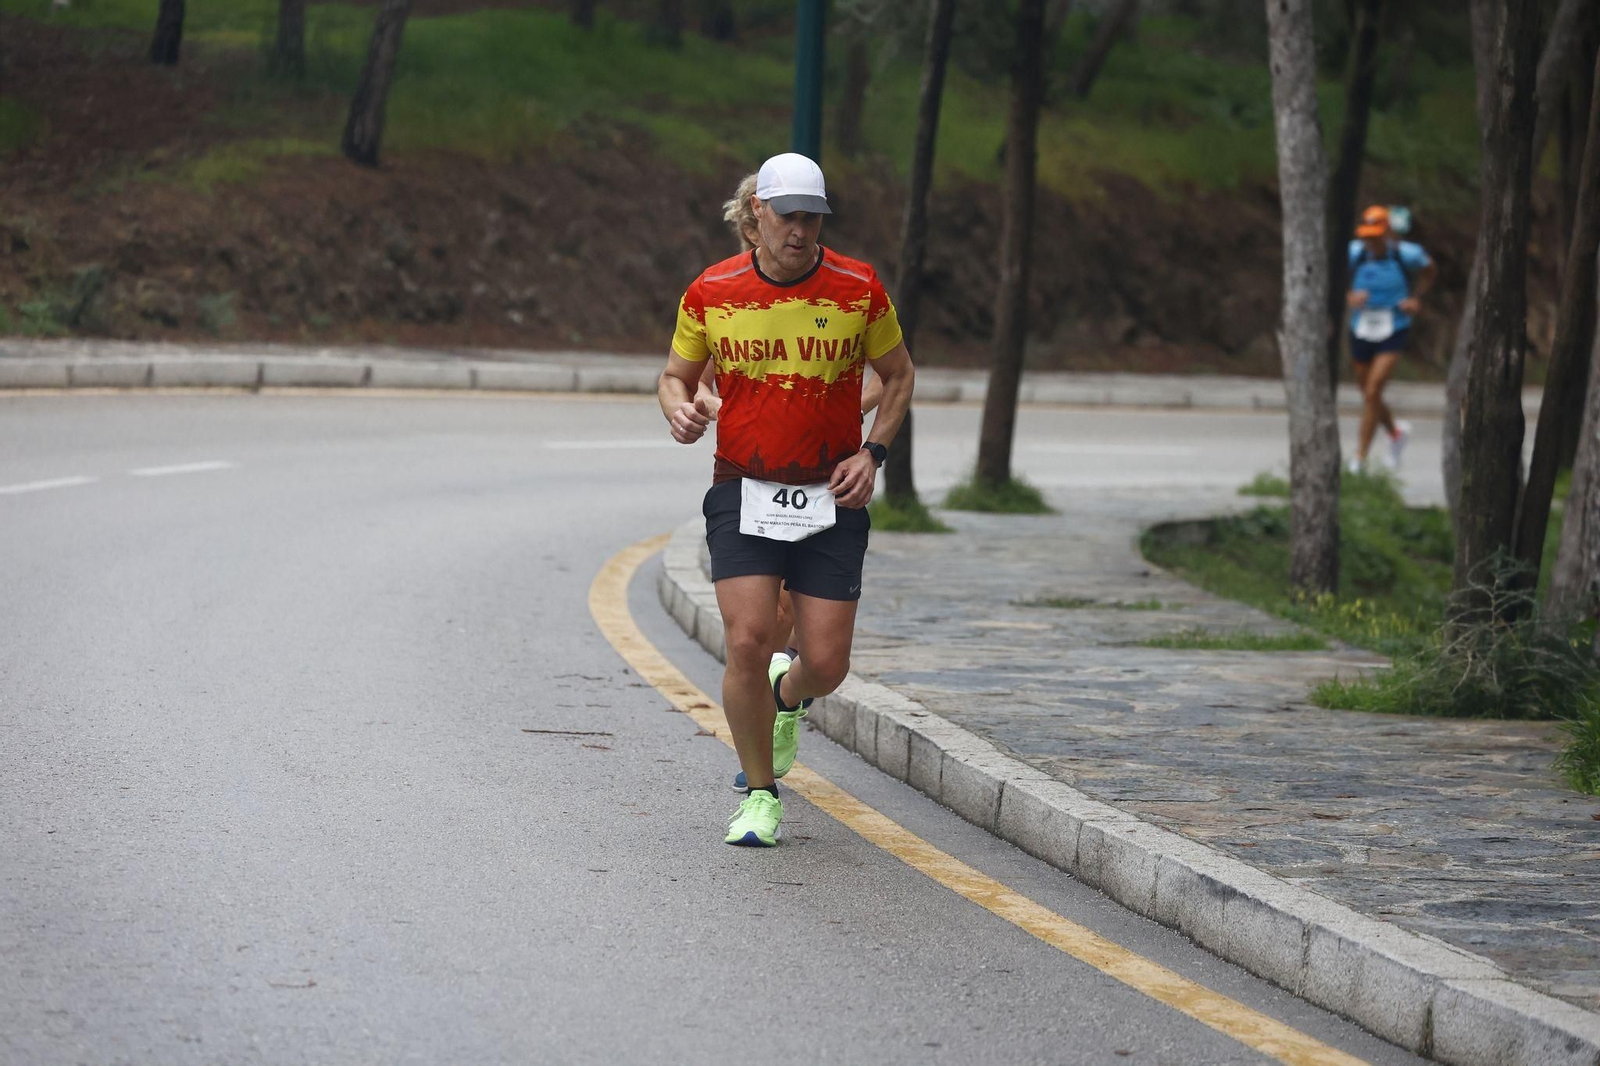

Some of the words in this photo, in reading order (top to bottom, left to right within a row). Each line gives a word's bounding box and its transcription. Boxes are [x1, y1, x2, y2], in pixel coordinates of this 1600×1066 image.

[713, 336, 788, 363] ¡ANSIA
[796, 333, 861, 362] VIVA!
[772, 488, 808, 510] 40
